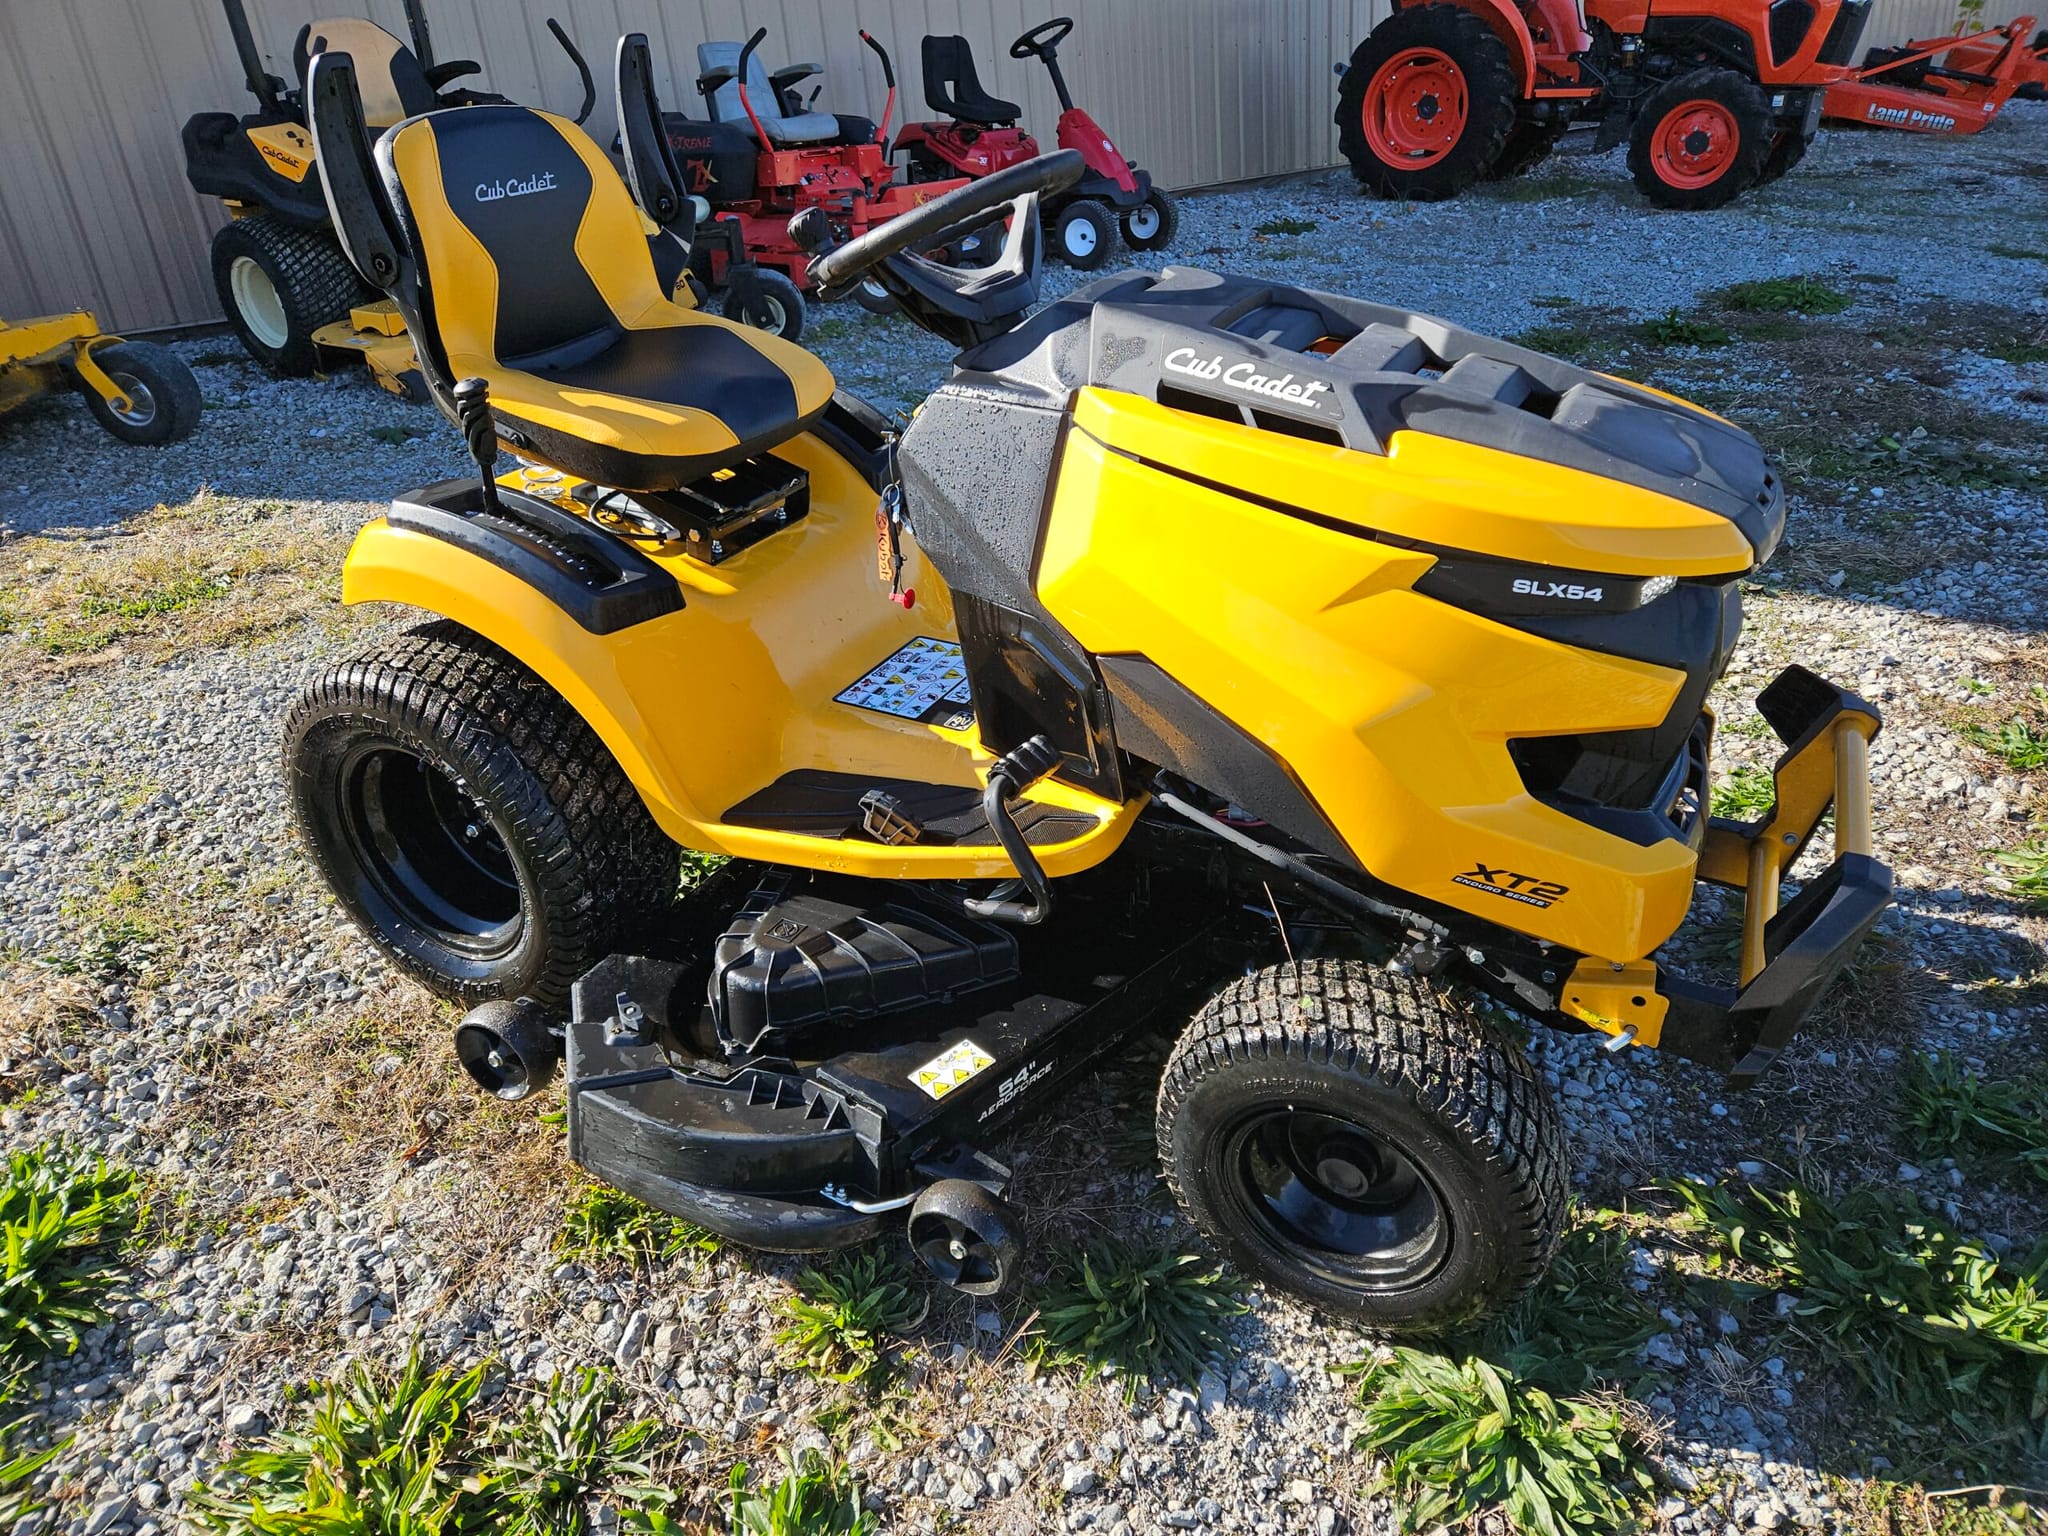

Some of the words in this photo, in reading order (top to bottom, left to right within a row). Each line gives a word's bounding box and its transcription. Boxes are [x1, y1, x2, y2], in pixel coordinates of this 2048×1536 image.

[1867, 102, 1909, 124] Land
[1908, 109, 1956, 131] Pride
[262, 145, 277, 158] Cub
[276, 152, 300, 168] Cadet
[475, 179, 505, 202] Cub
[506, 171, 557, 197] Cadet
[1164, 347, 1224, 380] Cub
[1222, 362, 1329, 408] Cadet
[1512, 578, 1603, 602] SLX54
[1454, 876, 1502, 894] ENDURO
[1505, 891, 1548, 906] SERIES
[1460, 862, 1570, 901] XT2
[977, 1060, 1055, 1123] AEROFORCE
[998, 1060, 1036, 1098] 54"
